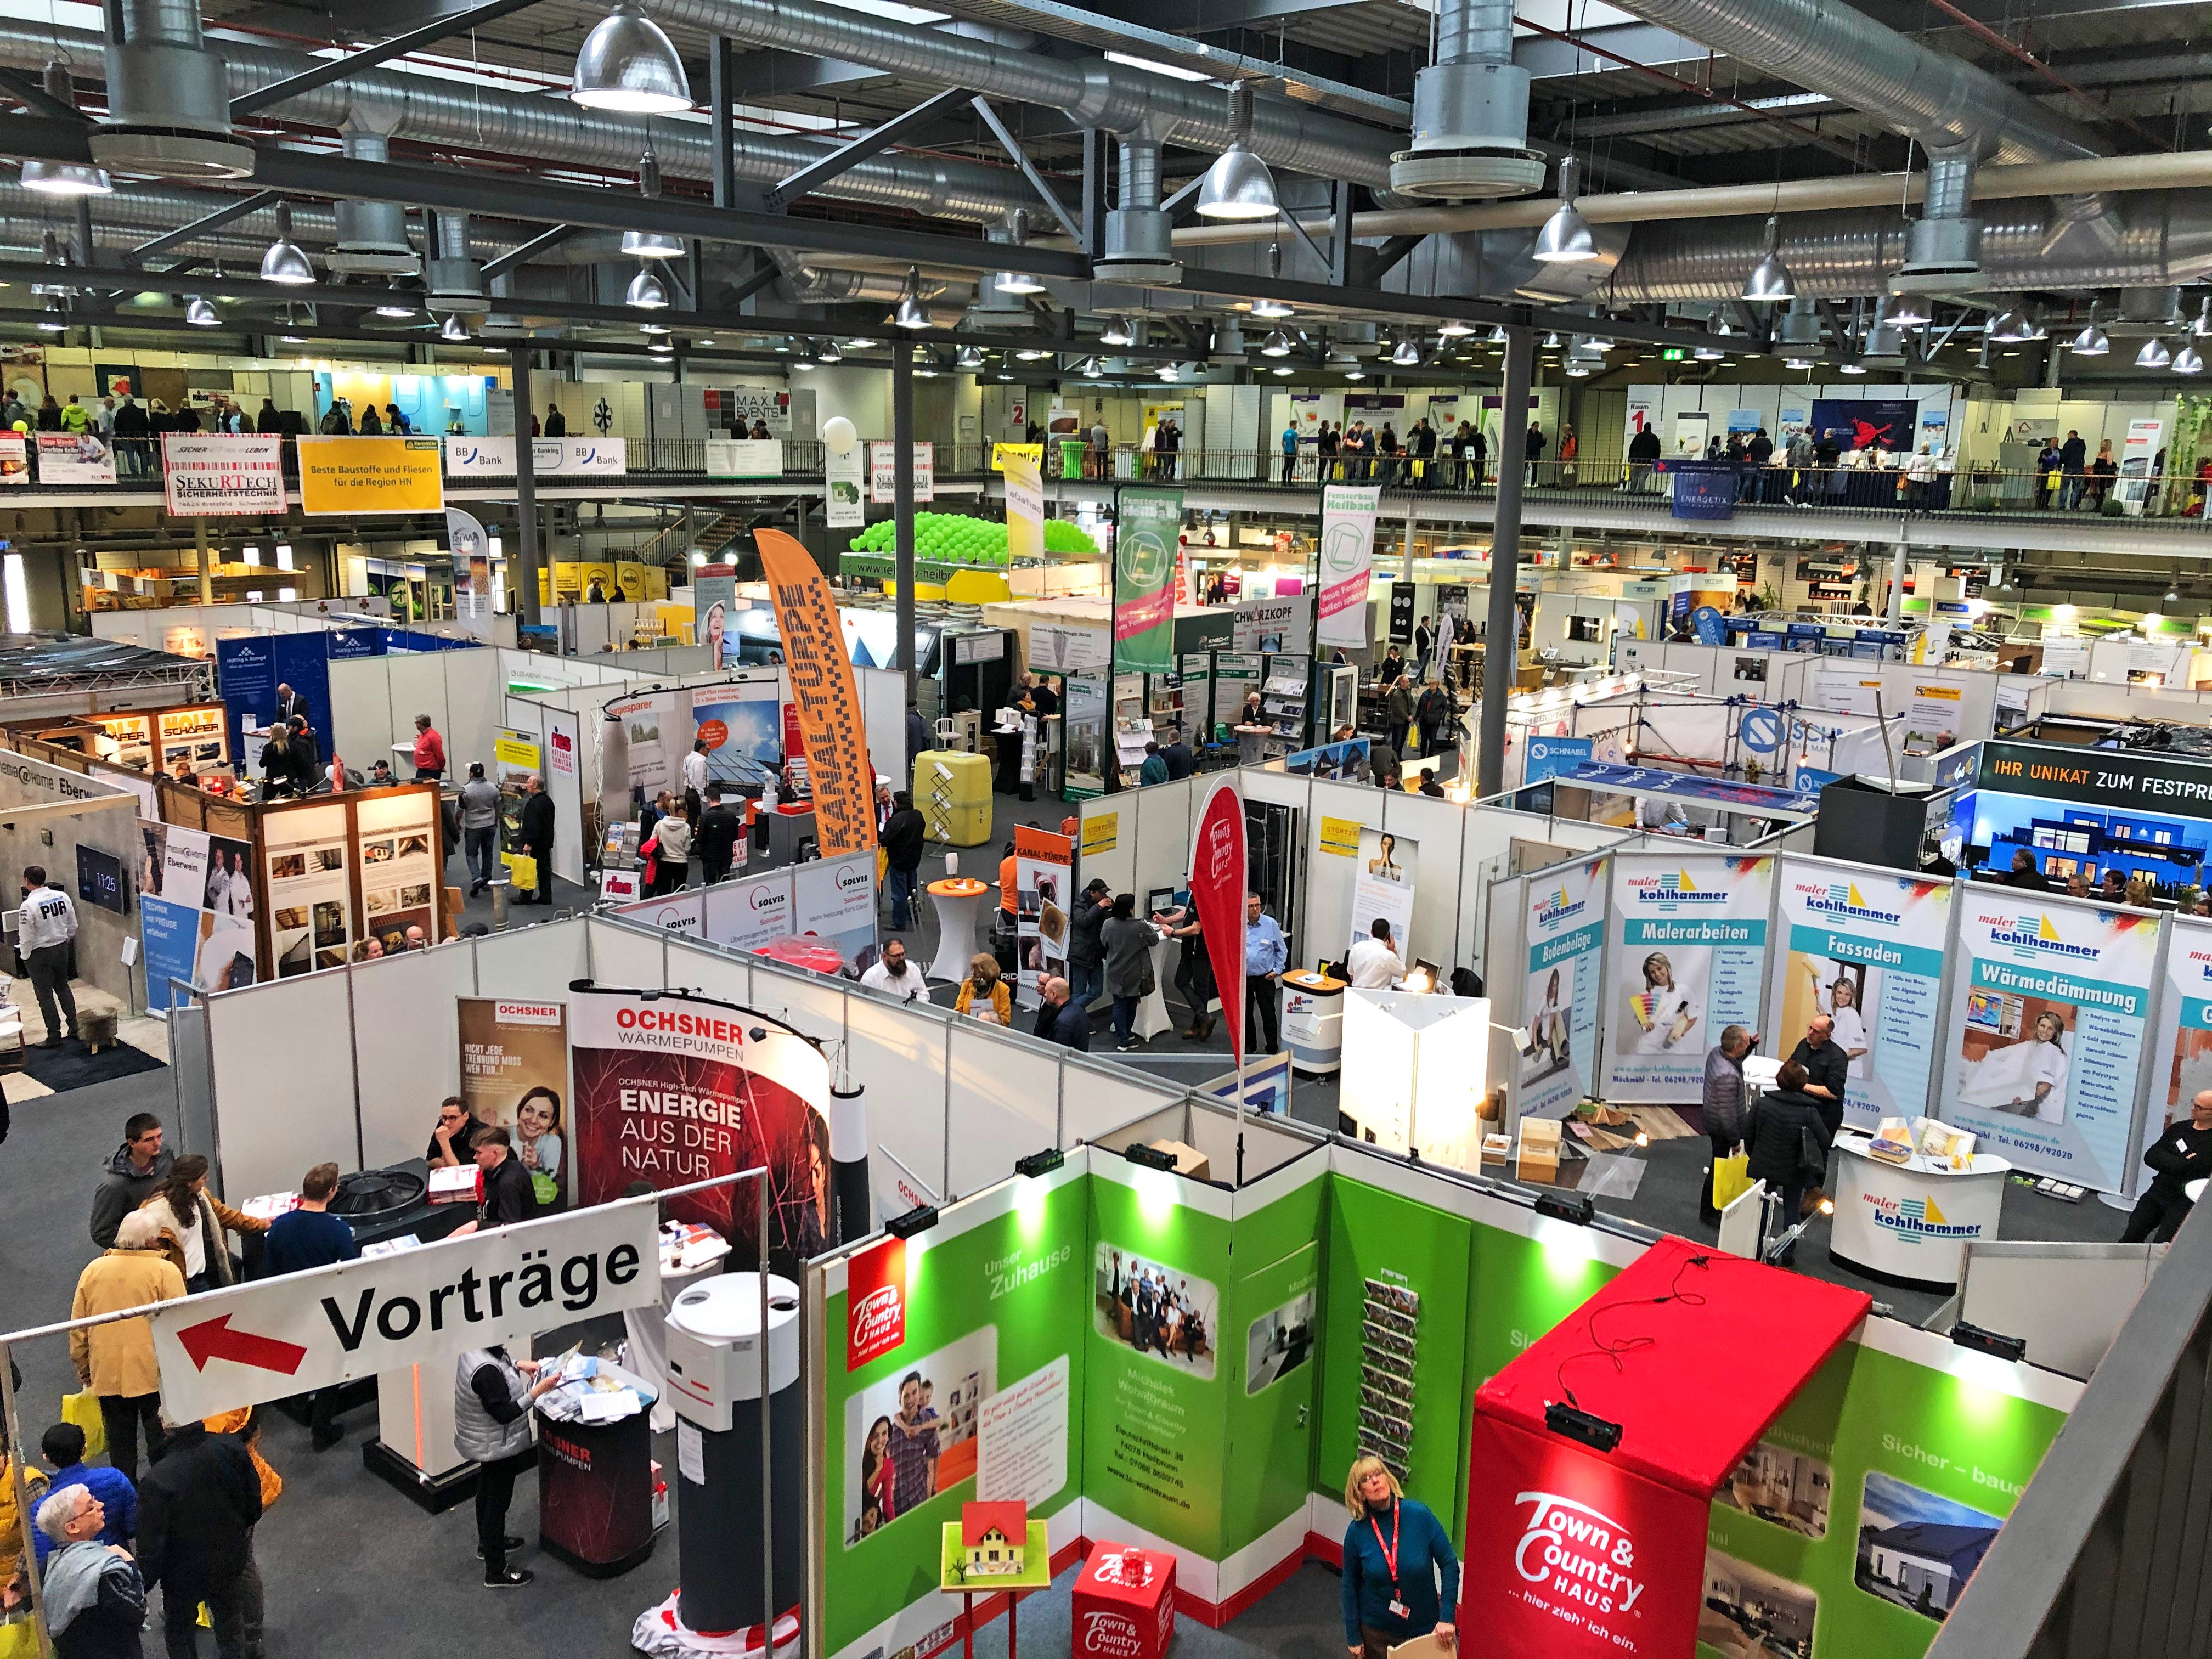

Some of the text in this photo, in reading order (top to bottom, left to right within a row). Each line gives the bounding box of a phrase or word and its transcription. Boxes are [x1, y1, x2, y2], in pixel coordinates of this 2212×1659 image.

[737, 407, 779, 418] EVENTS
[1013, 405, 1023, 423] 2
[1632, 411, 1644, 433] 1
[456, 447, 468, 456] BB
[538, 447, 559, 455] Banking
[575, 448, 587, 456] BB
[479, 455, 502, 465] Bank
[597, 456, 617, 465] Bank
[311, 465, 432, 474] Beste Baustoffe und Fliesen
[334, 477, 412, 488] für die Region HN
[177, 489, 278, 498] SICHERHEITSTECHNIK
[1327, 492, 1373, 501] Fensterbau
[1680, 495, 1727, 504] ENERGETIX
[1322, 574, 1368, 603] Neue Fenster
[1234, 606, 1292, 626] CHWARZKOPF
[1320, 600, 1342, 615] helfen
[165, 712, 215, 728] HOLZ
[777, 583, 851, 849] KANAL-TÜRPE
[164, 723, 218, 736] SCHÄFER
[551, 748, 571, 760] HEIZUNG
[1550, 747, 1588, 756] SCHNABEL
[1995, 760, 2023, 777] IHR
[2030, 764, 2090, 785] UNIKAT
[2096, 772, 2134, 791] ZUM
[1017, 847, 1069, 864] KANAL-TÜRPE
[167, 857, 198, 872] Eberwein
[606, 876, 632, 894] ries
[843, 874, 868, 887] SOLVIS
[1628, 877, 1660, 887] maler
[1795, 882, 1828, 895] maler
[758, 894, 785, 907] SOLVIS
[1639, 888, 1728, 900] kohlhammer
[40, 901, 67, 920] PUR
[1533, 899, 1550, 912] maler
[1539, 900, 1585, 924] kohlhammer
[1806, 896, 1901, 923] kohlhammer
[666, 917, 696, 929] SOLVIS
[823, 909, 843, 920] Heizung
[1978, 914, 2016, 928] maler
[1641, 922, 1748, 940] Malerarbeiten
[1542, 932, 1592, 963] Bodenbeläge
[1828, 935, 1902, 965] Fassaden
[1991, 928, 2100, 958] kohlhammer
[1982, 963, 2136, 1014] Wärmedämmung
[499, 1005, 556, 1017] OCHSNER
[2090, 1013, 2111, 1022] Analyse
[617, 1008, 743, 1046] OCHSNER
[465, 1043, 503, 1056] NICHT JEDE
[618, 1031, 743, 1062] WÄRMEPUMPEN
[465, 1053, 521, 1066] TRENNUNG MUSS
[465, 1064, 480, 1074] WEH
[1652, 1075, 1662, 1084] Tel.
[619, 1077, 747, 1108] OCHSNER High-Tech Wärmepumpen
[620, 1089, 741, 1130] ENERGIE
[620, 1118, 731, 1156] AUS DER
[1999, 1135, 2073, 1161] Tel. 06298/92020
[623, 1146, 709, 1178] NATUR
[1863, 1193, 1899, 1210] maler
[1875, 1209, 1982, 1234] kohlhammer
[984, 1249, 1022, 1277] Unser
[990, 1244, 1071, 1301] Zuhause
[321, 1244, 640, 1352] Vorträge
[854, 1302, 902, 1348] Country
[868, 1321, 891, 1340] HAUS
[1882, 1434, 1949, 1470] Sicher
[1515, 1491, 1635, 1568] Town &
[1515, 1528, 1645, 1612] Country
[1554, 1575, 1613, 1613] HAUS
[1084, 1611, 1137, 1637] Town &
[1523, 1589, 1638, 1653] hier zieh' ich ein.
[1085, 1627, 1141, 1655] Country
[1103, 1646, 1129, 1657] HAUS
